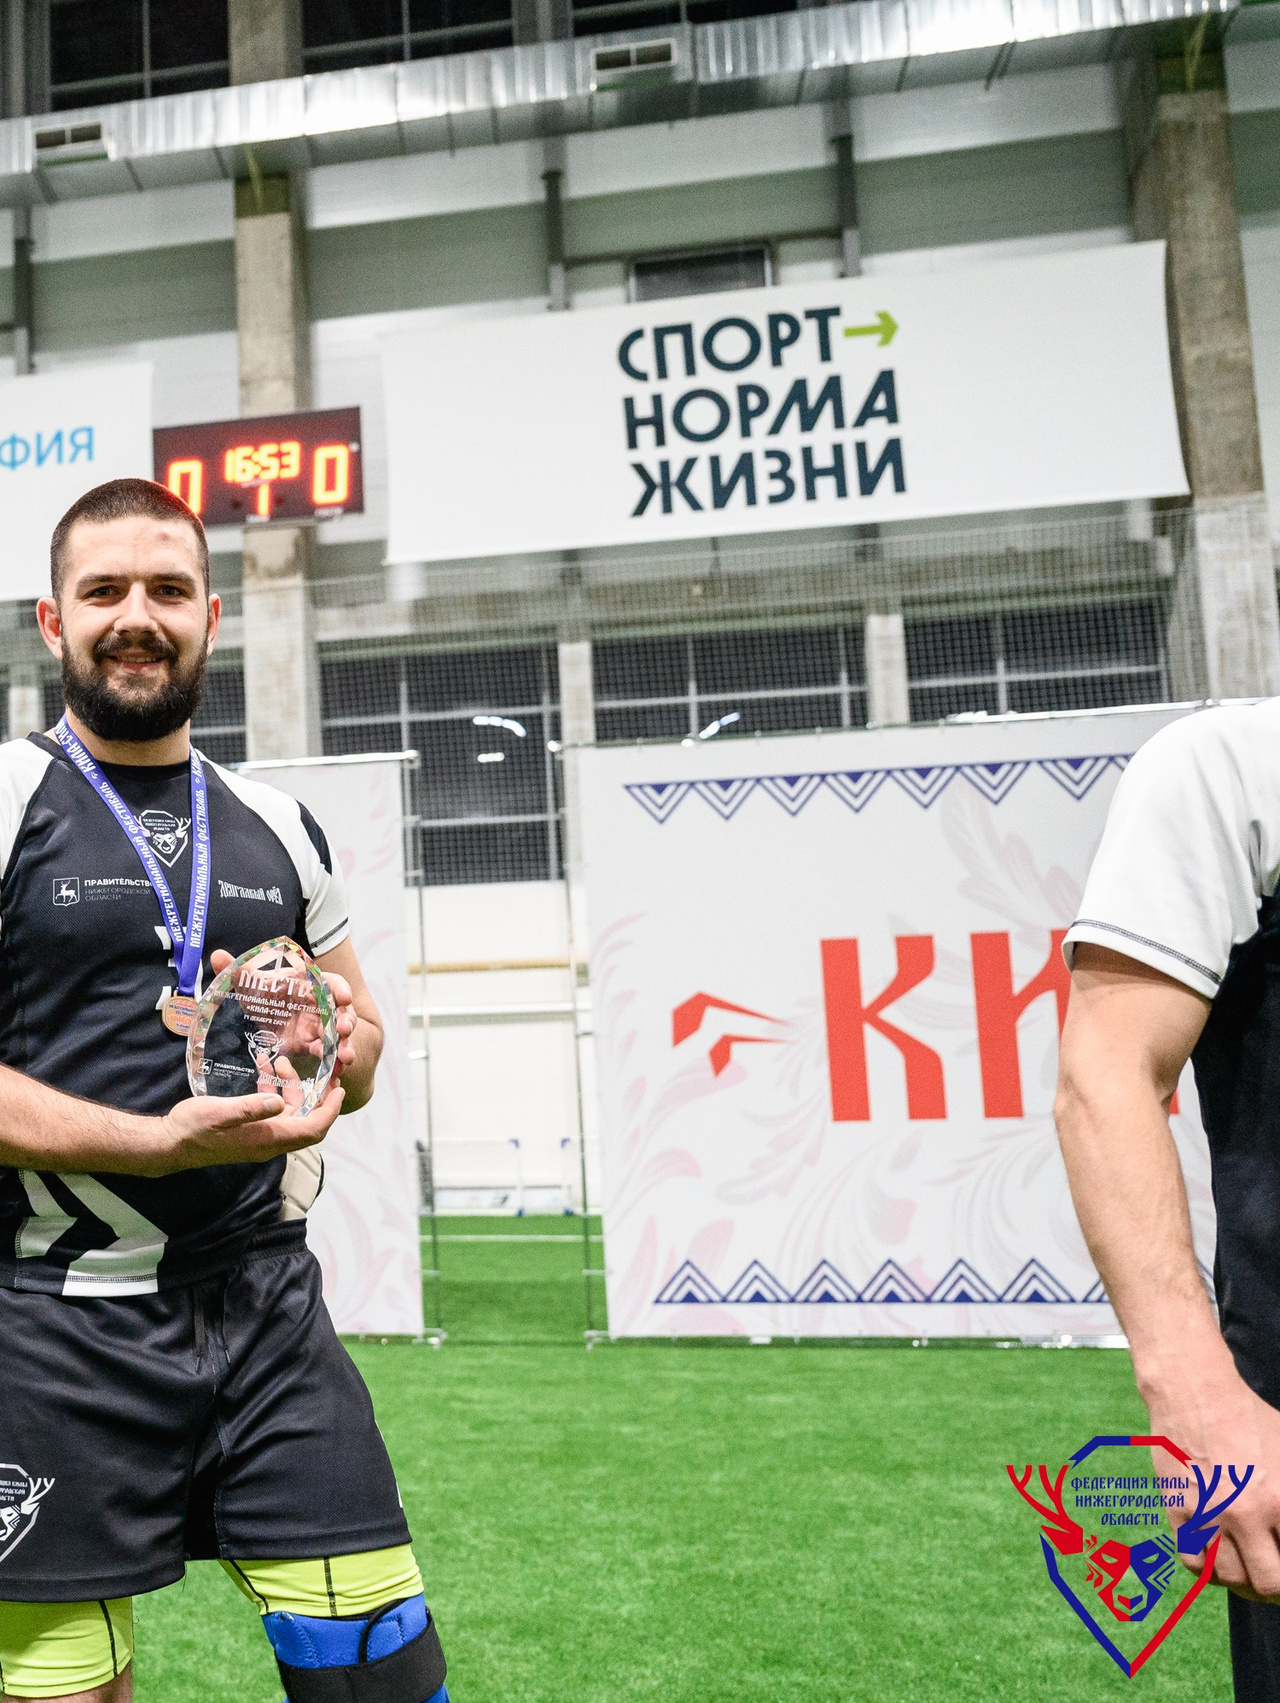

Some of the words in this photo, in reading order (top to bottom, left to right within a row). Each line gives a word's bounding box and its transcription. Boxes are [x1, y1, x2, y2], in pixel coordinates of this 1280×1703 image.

[617, 306, 841, 382] СПОРТ
[623, 369, 900, 450] НОРМА
[224, 441, 301, 484] 16:53
[313, 444, 350, 505] 0
[630, 438, 907, 518] ЖИЗНИ
[99, 781, 139, 837] ФЕСТИВАЛЬ
[196, 789, 210, 842] ФЕСТИВАЛЬ
[133, 836, 185, 942] МЕЖРЕГИОНАЛЬНЫЙ
[189, 842, 209, 948] МЕЖРЕГИОНАЛЬНЫЙ
